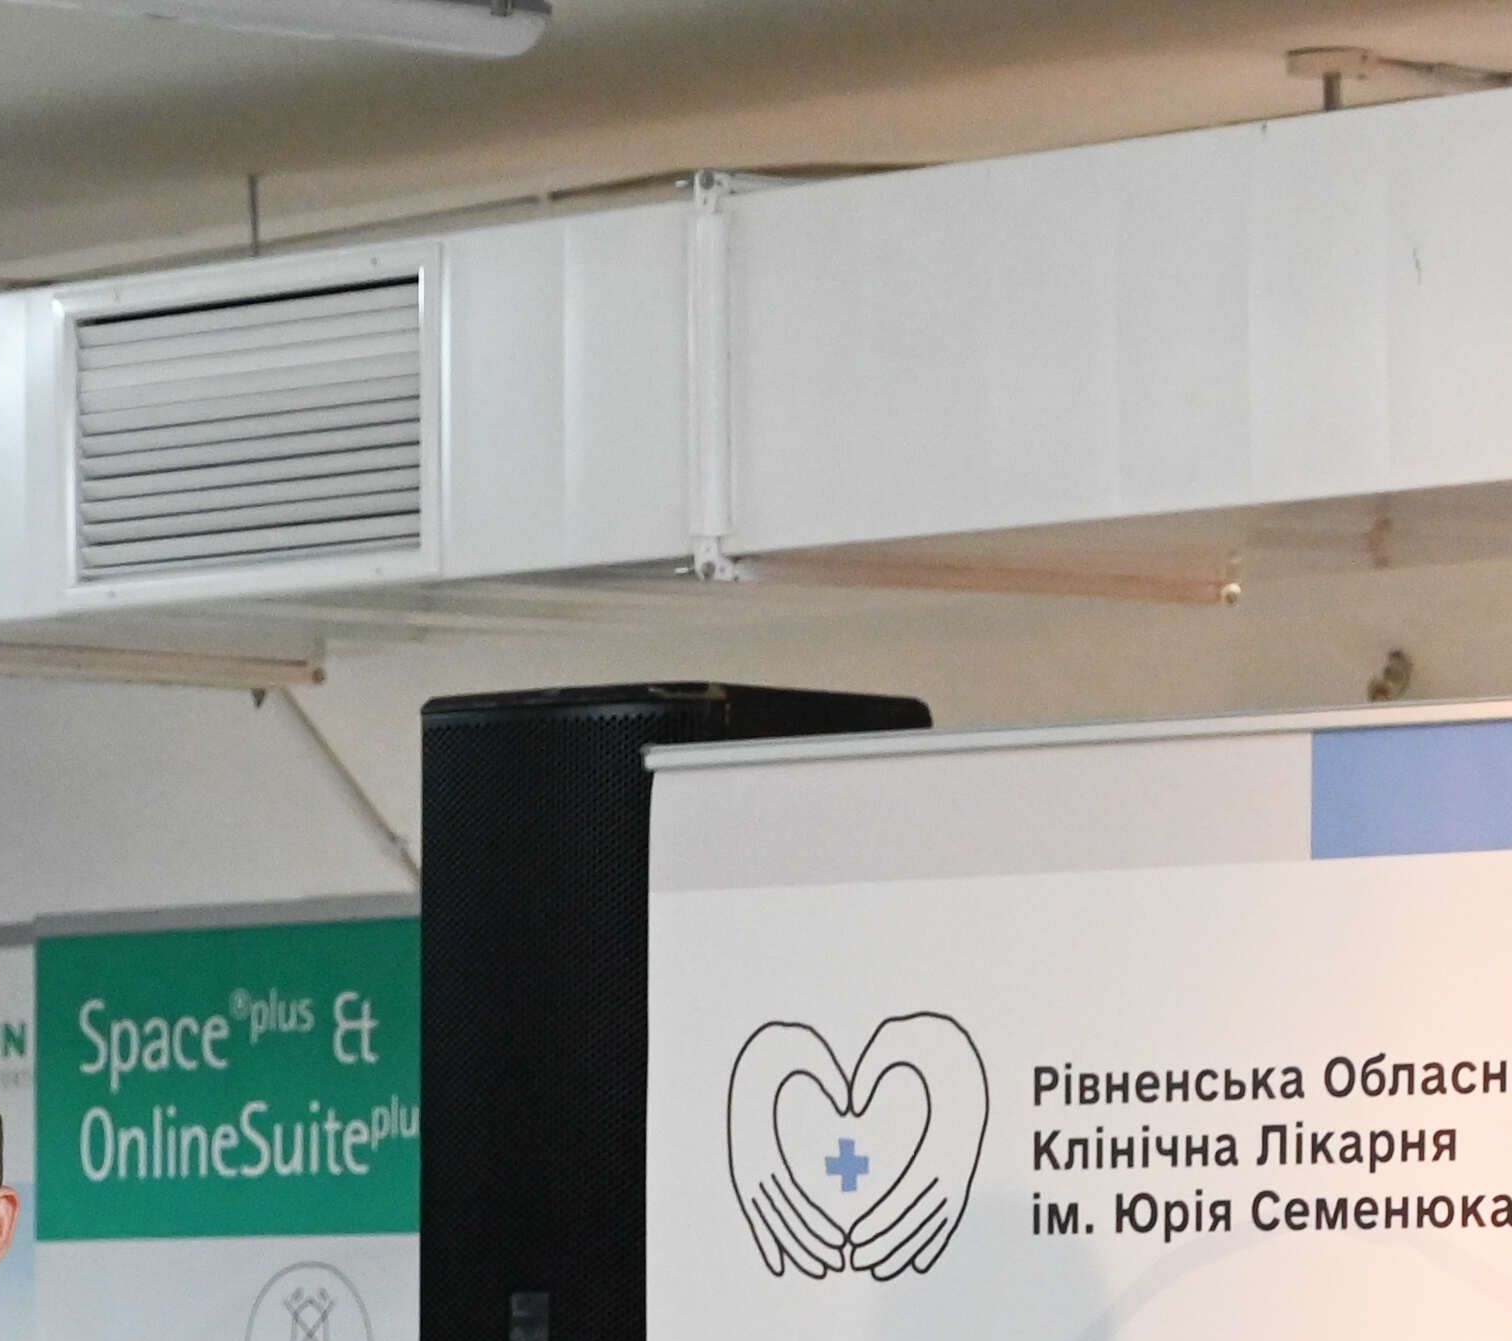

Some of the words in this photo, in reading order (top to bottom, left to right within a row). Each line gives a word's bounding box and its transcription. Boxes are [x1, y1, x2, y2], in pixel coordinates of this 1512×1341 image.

[333, 990, 379, 1065] &
[1033, 1062, 1305, 1107] Рівненська
[1033, 1124, 1239, 1171] Клінічна
[1256, 1120, 1457, 1174] Лікарня
[1032, 1192, 1094, 1236] ім.
[1115, 1188, 1232, 1244] Юрія
